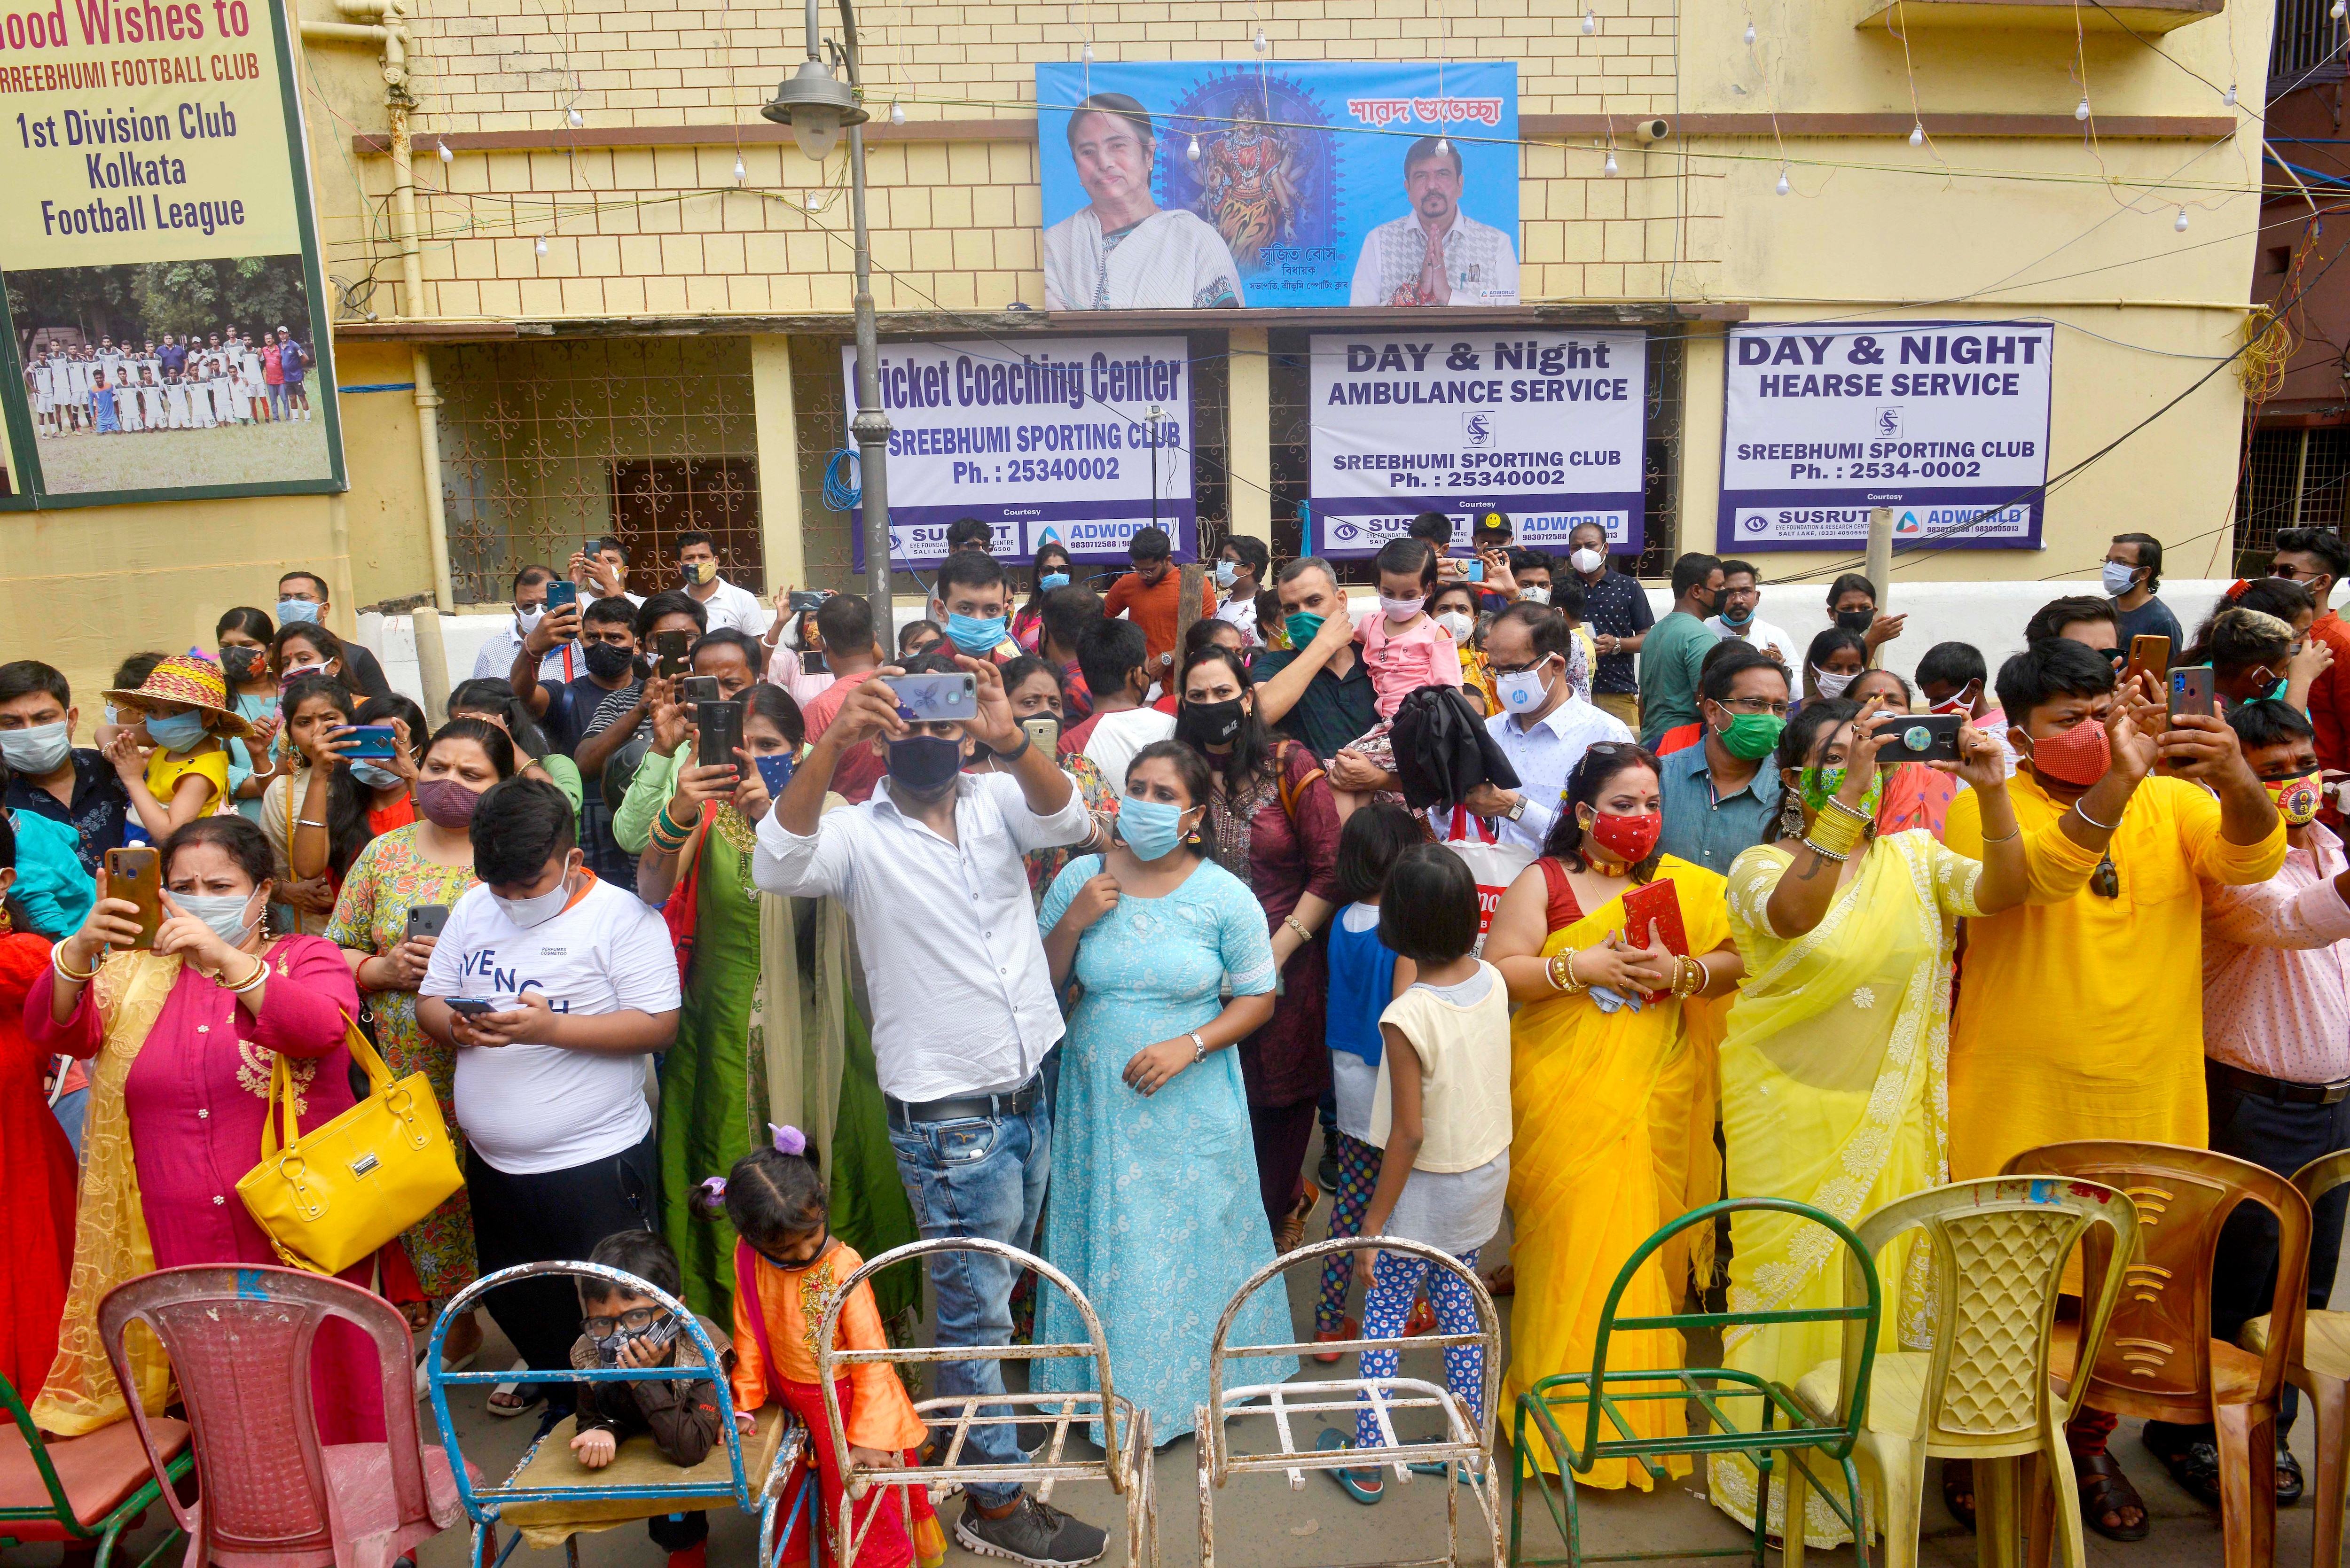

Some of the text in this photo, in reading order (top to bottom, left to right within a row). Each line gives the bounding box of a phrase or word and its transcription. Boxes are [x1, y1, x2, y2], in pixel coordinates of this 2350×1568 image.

[0, 0, 249, 50] ood Wishes to
[112, 56, 206, 87] FOOTBALL
[211, 53, 259, 81] CLUB
[1350, 100, 1501, 125] শারদ শুভেচ্ছা
[16, 101, 236, 148] 1st Division Club
[86, 151, 186, 189] Kolkata
[41, 194, 244, 235] Football League
[1259, 242, 1337, 266] সুজিত বোস
[1282, 263, 1316, 275] বিধায়ক
[1347, 341, 1610, 376] DAY & Night
[1739, 336, 2042, 366] DAY & NIGHT
[853, 351, 1181, 409] icket Coaching Center
[1760, 373, 2020, 398] HEARSE SERVICE
[1328, 378, 1628, 405] AMBULANCE SERVICE
[889, 421, 1181, 456] SREEBHUMI SPORTING CLUB
[1333, 450, 1621, 470] SREEBHUMI SPORTING CLUB
[1738, 441, 2035, 460] SREEBHUMI SPORTING CLUB
[953, 461, 988, 484] Ph.
[1008, 457, 1120, 483] 25340002
[1390, 473, 1427, 488] Ph.
[1448, 470, 1565, 487] 25340002
[1790, 463, 1828, 479] Ph.
[1849, 461, 1980, 479] 2534-0002
[1459, 501, 1496, 509] Courtesy
[1867, 492, 1903, 501] Courtesy
[1003, 508, 1041, 517] Courtesy
[1778, 510, 1871, 523] SUSRUT
[1927, 509, 2021, 523] ADWORLD
[912, 526, 1010, 541] SUT
[1071, 523, 1170, 538] ADWORD
[1369, 517, 1465, 531] SUST
[2280, 791, 2290, 805] EAST
[2290, 783, 2311, 792] BENGAL
[2288, 812, 2313, 822] KOLKATA
